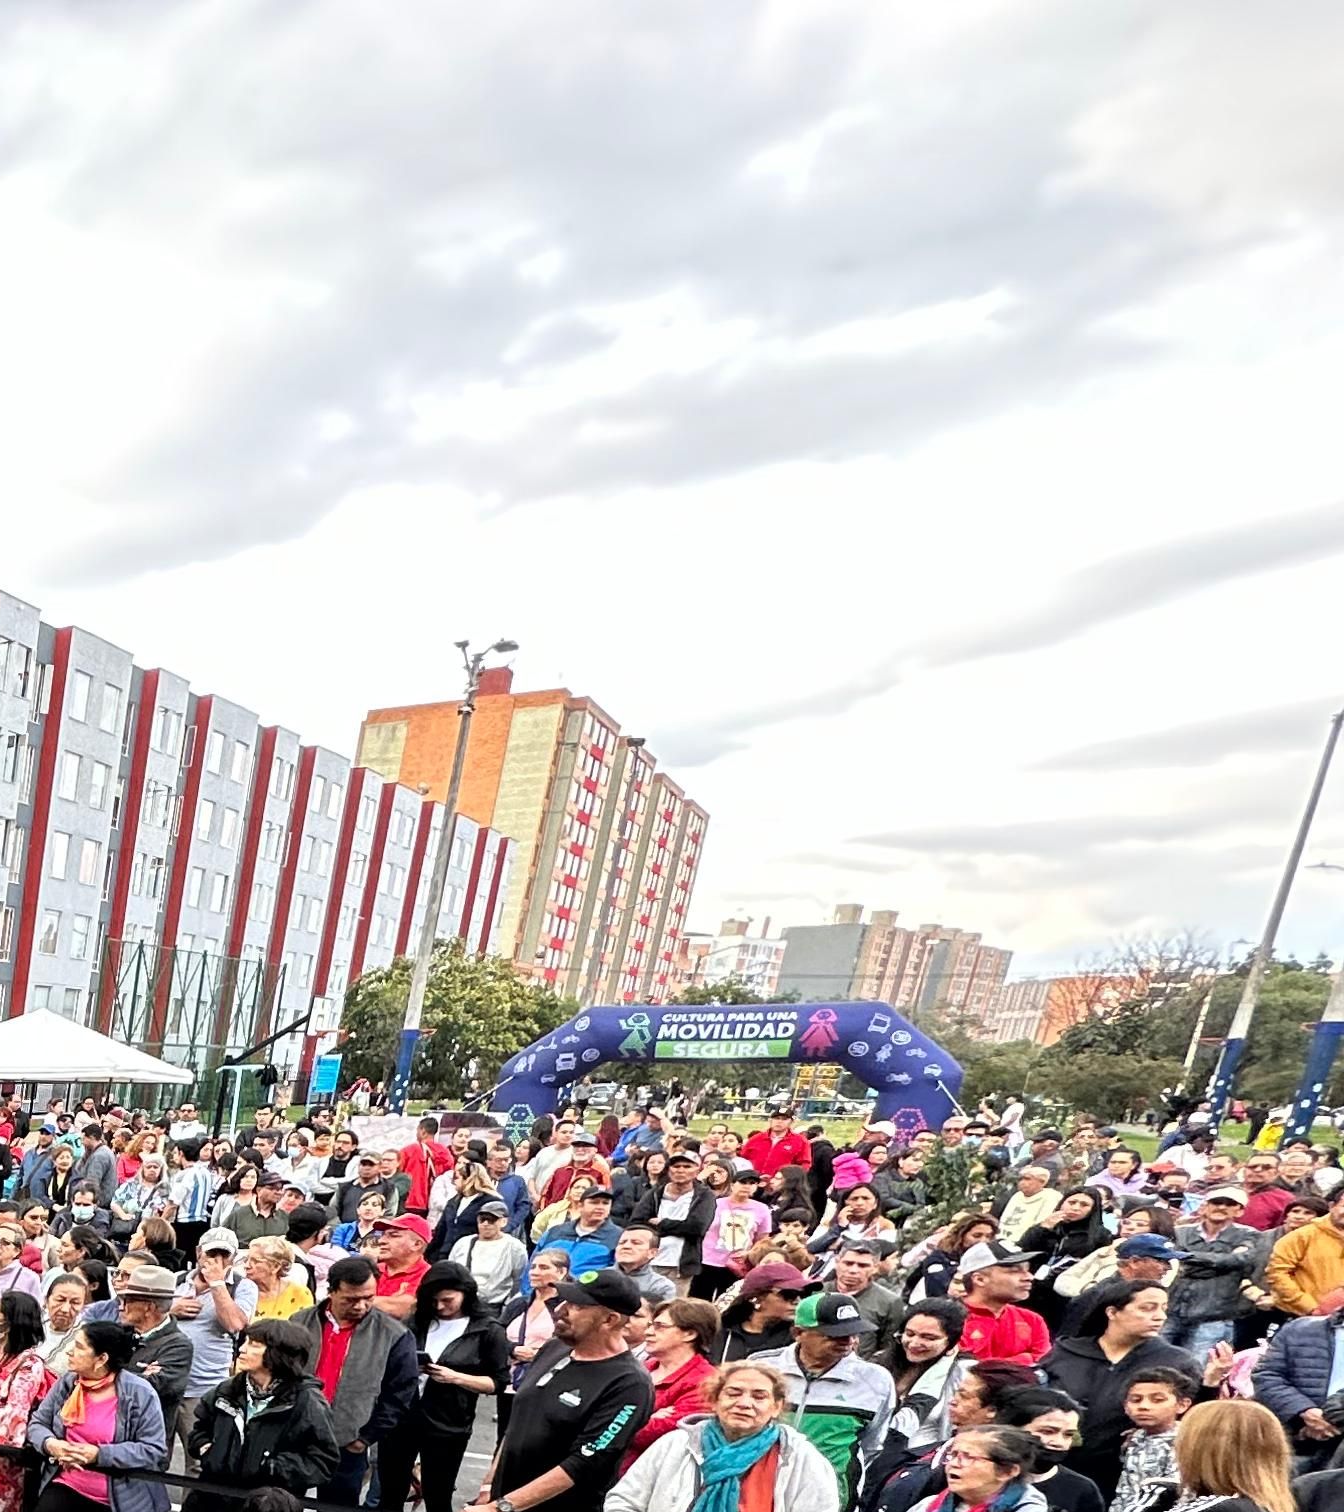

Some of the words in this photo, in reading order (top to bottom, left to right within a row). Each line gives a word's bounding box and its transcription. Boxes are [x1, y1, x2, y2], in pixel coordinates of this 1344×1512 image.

[661, 1012, 725, 1023] CULTURA
[726, 1012, 764, 1022] PARA
[766, 1011, 798, 1021] UNA
[656, 1022, 796, 1040] MOVILIDAD
[672, 1041, 770, 1058] SEGURA
